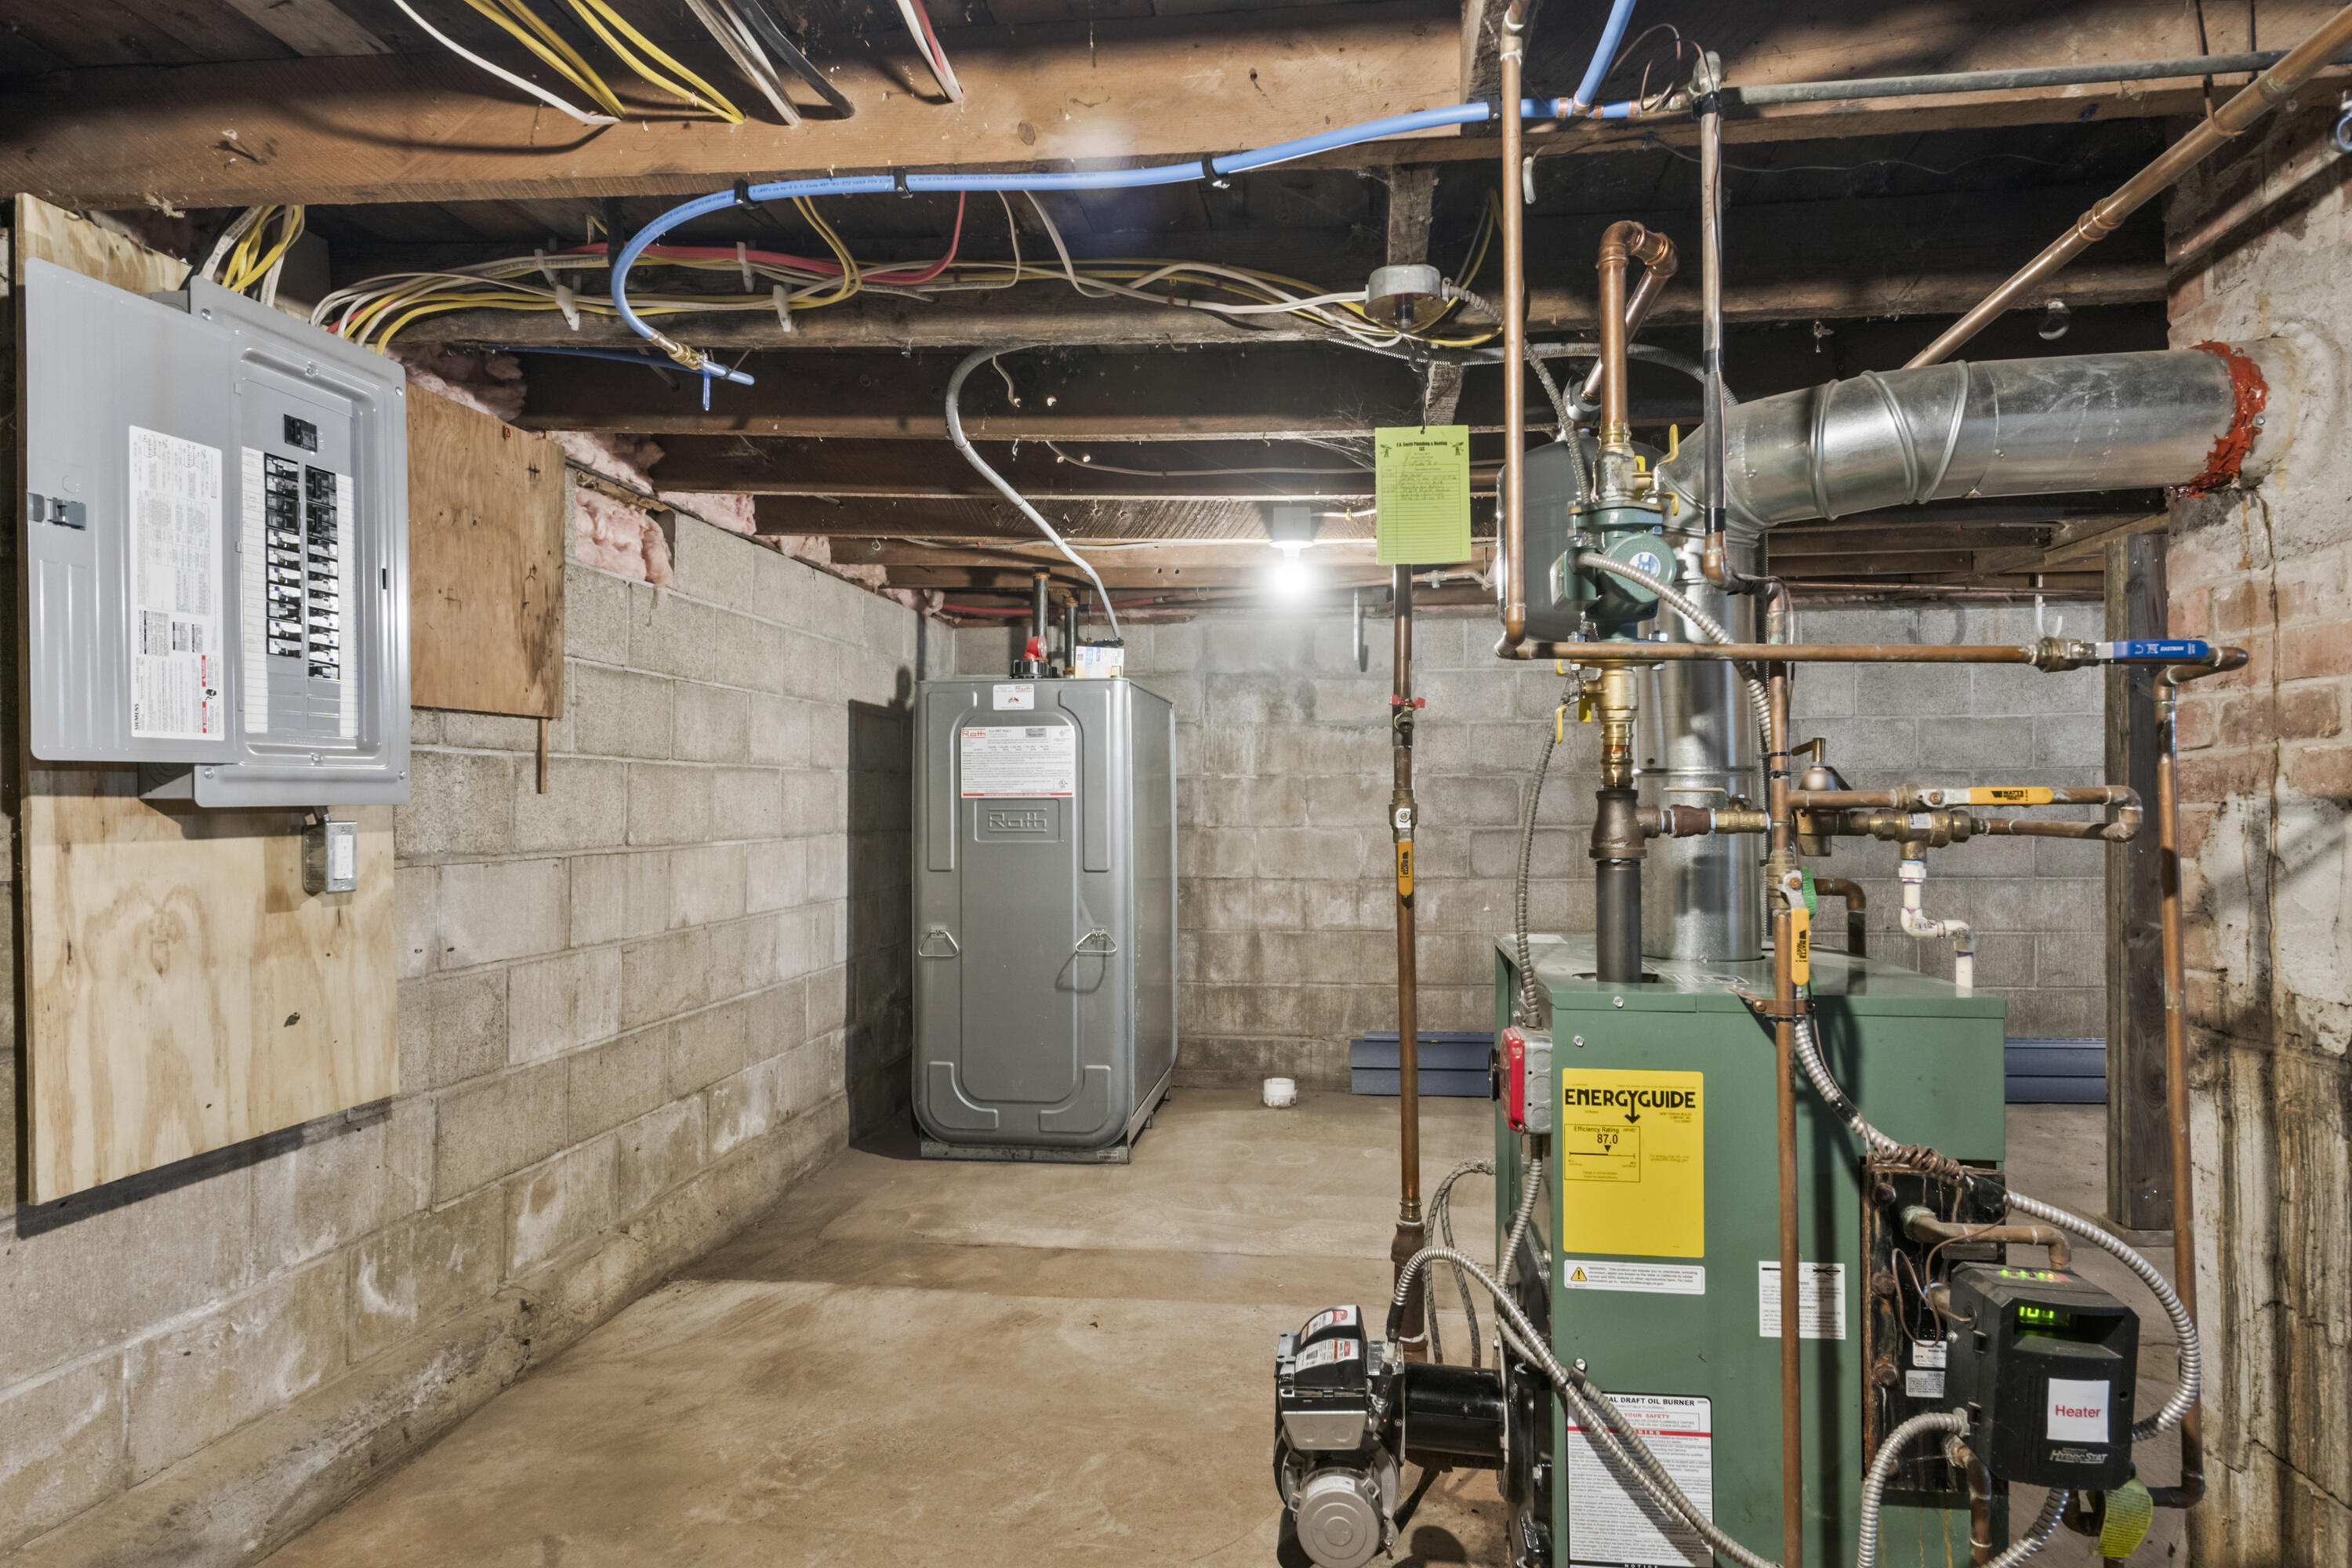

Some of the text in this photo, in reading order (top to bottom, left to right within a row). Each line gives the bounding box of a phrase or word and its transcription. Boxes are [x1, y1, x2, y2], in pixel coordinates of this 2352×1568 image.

[962, 729, 986, 738] Roth
[989, 811, 1047, 829] Roth
[1565, 1088, 1696, 1109] ENERGYGUIDE
[1597, 1134, 1619, 1145] 87.0
[2055, 1404, 2101, 1418] Heater
